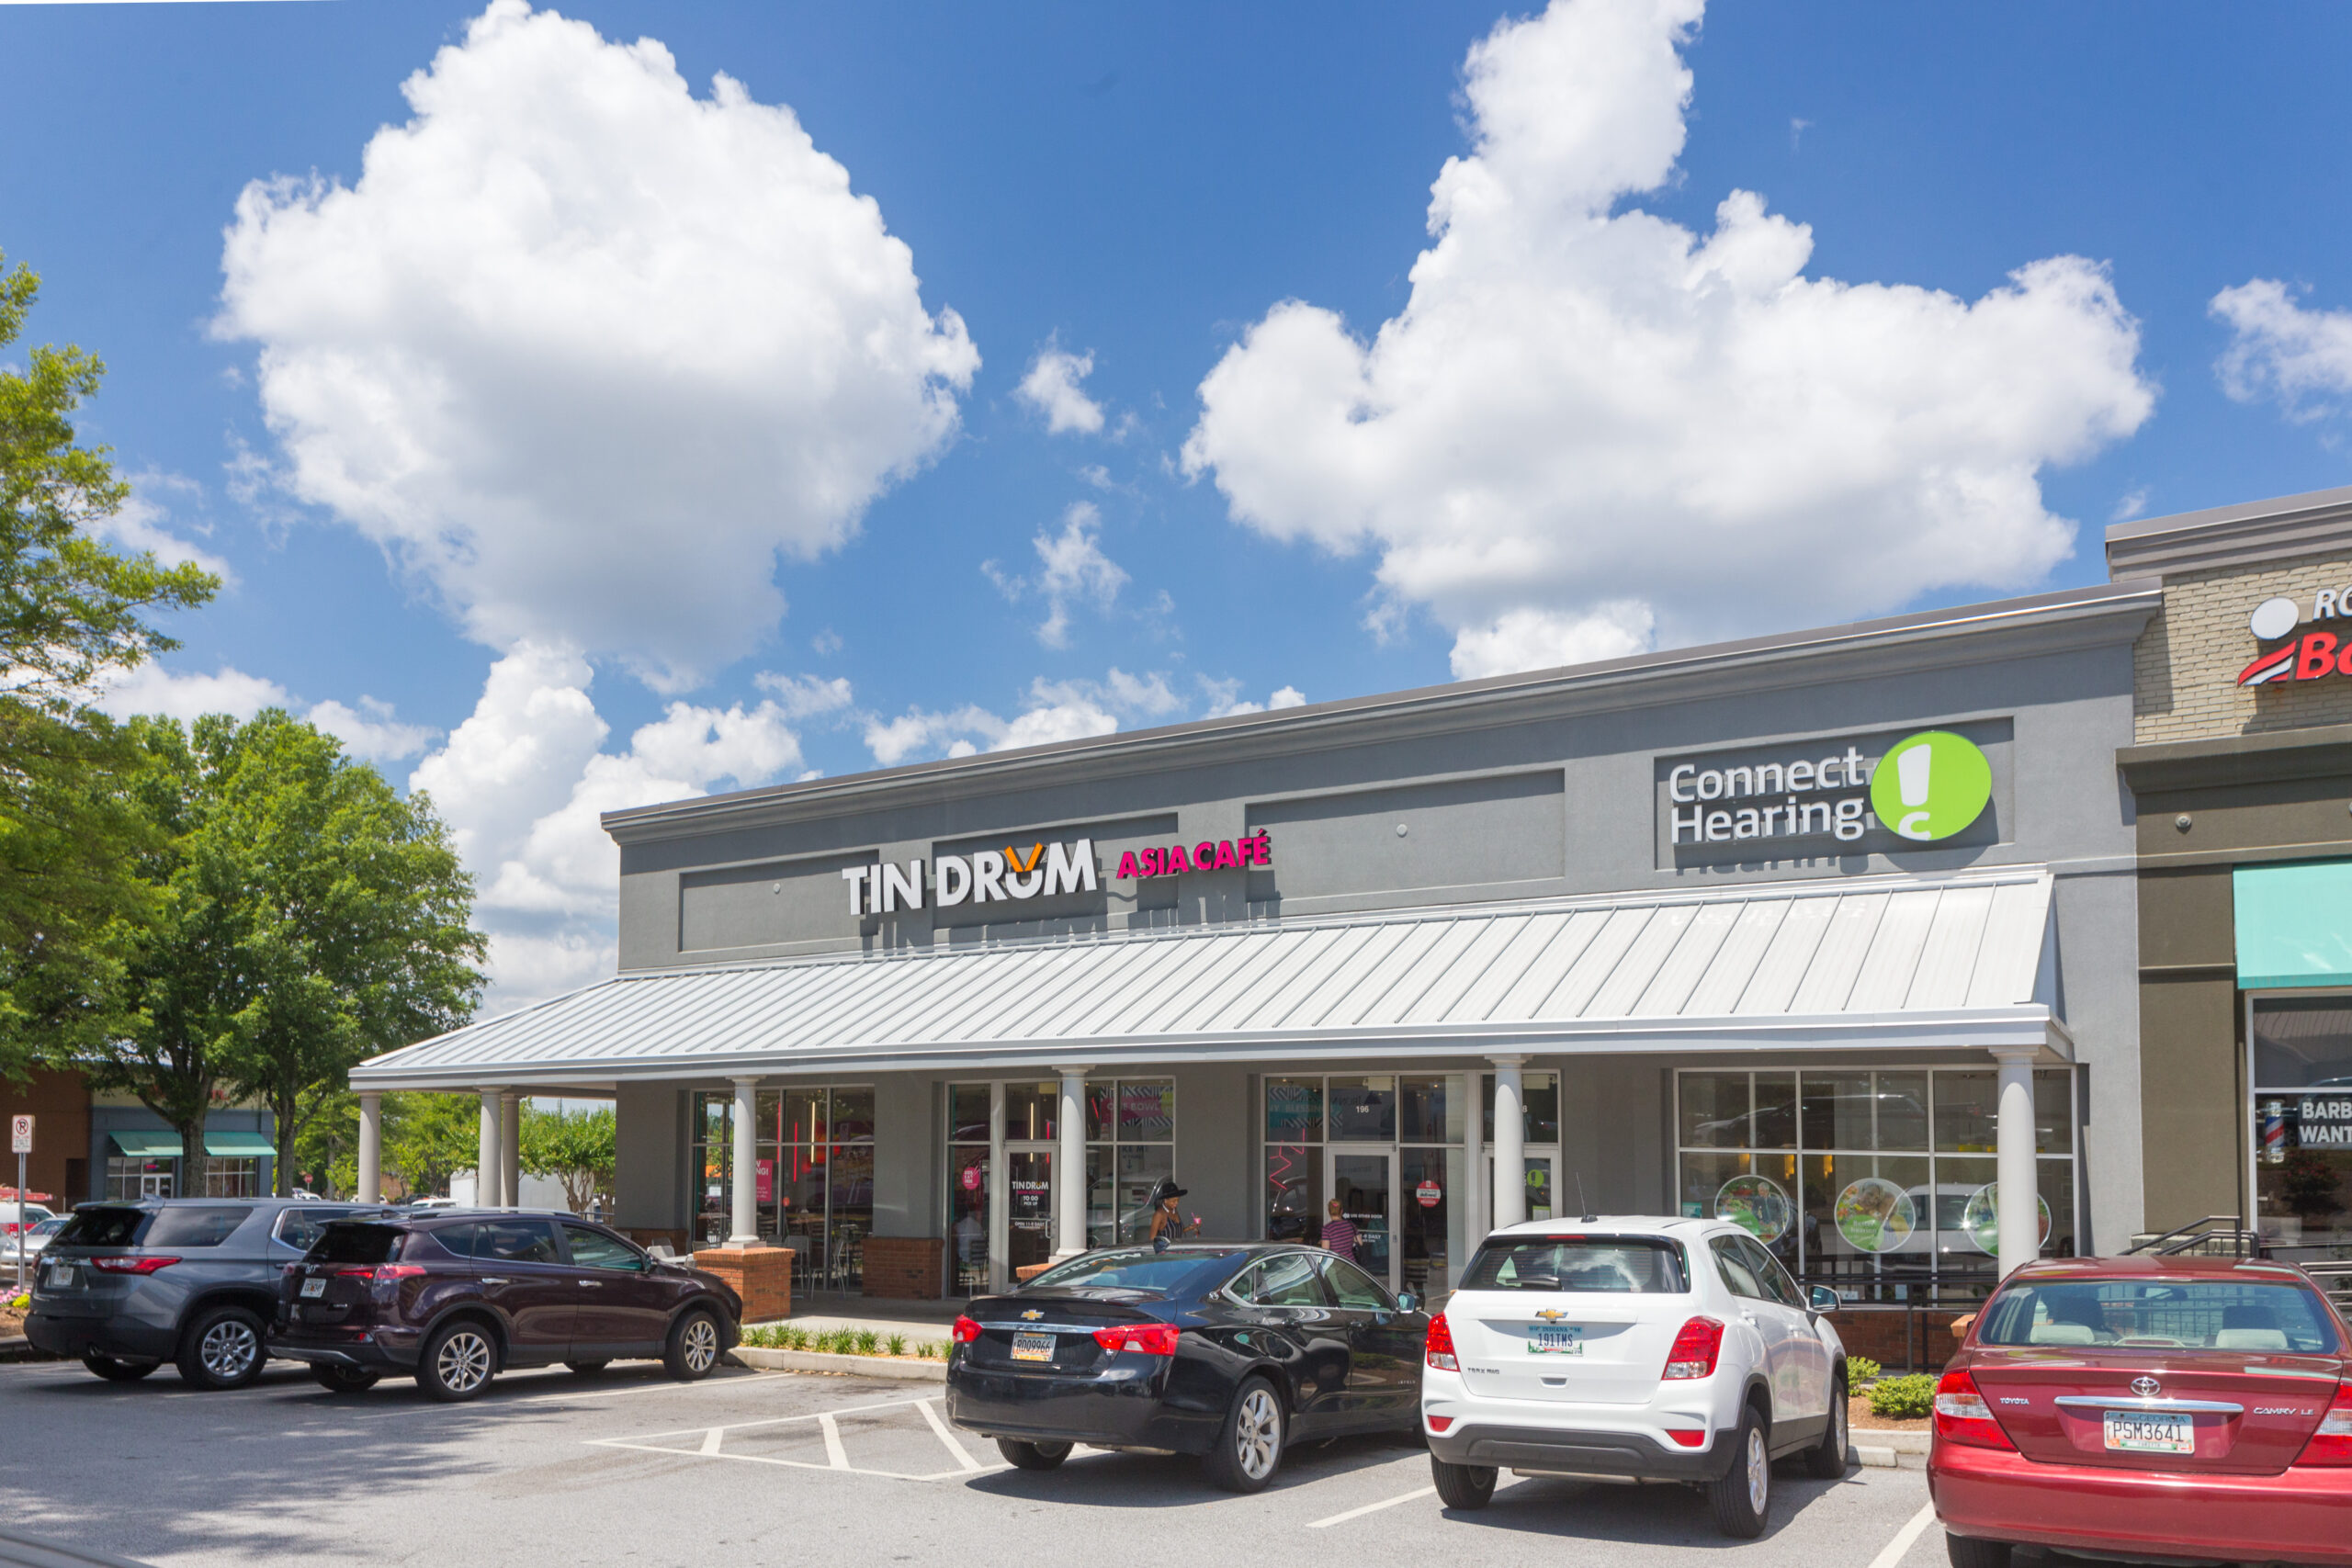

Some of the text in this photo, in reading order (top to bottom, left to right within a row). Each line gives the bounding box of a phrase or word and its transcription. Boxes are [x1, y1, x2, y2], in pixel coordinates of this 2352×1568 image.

[1669, 746, 1864, 803] Connect
[1671, 795, 1865, 841] Hearing
[1116, 829, 1272, 880] ASIA CAFÉ
[842, 837, 1099, 916] TIN DRUM
[1356, 1105, 1369, 1113] 196
[1012, 1180, 1049, 1190] TIN DRUM
[1999, 1396, 2030, 1405] TOYOTA
[2253, 1407, 2314, 1416] CAMRY LE
[2139, 1415, 2187, 1425] GEORGIA
[2113, 1421, 2185, 1443] PSM3641
